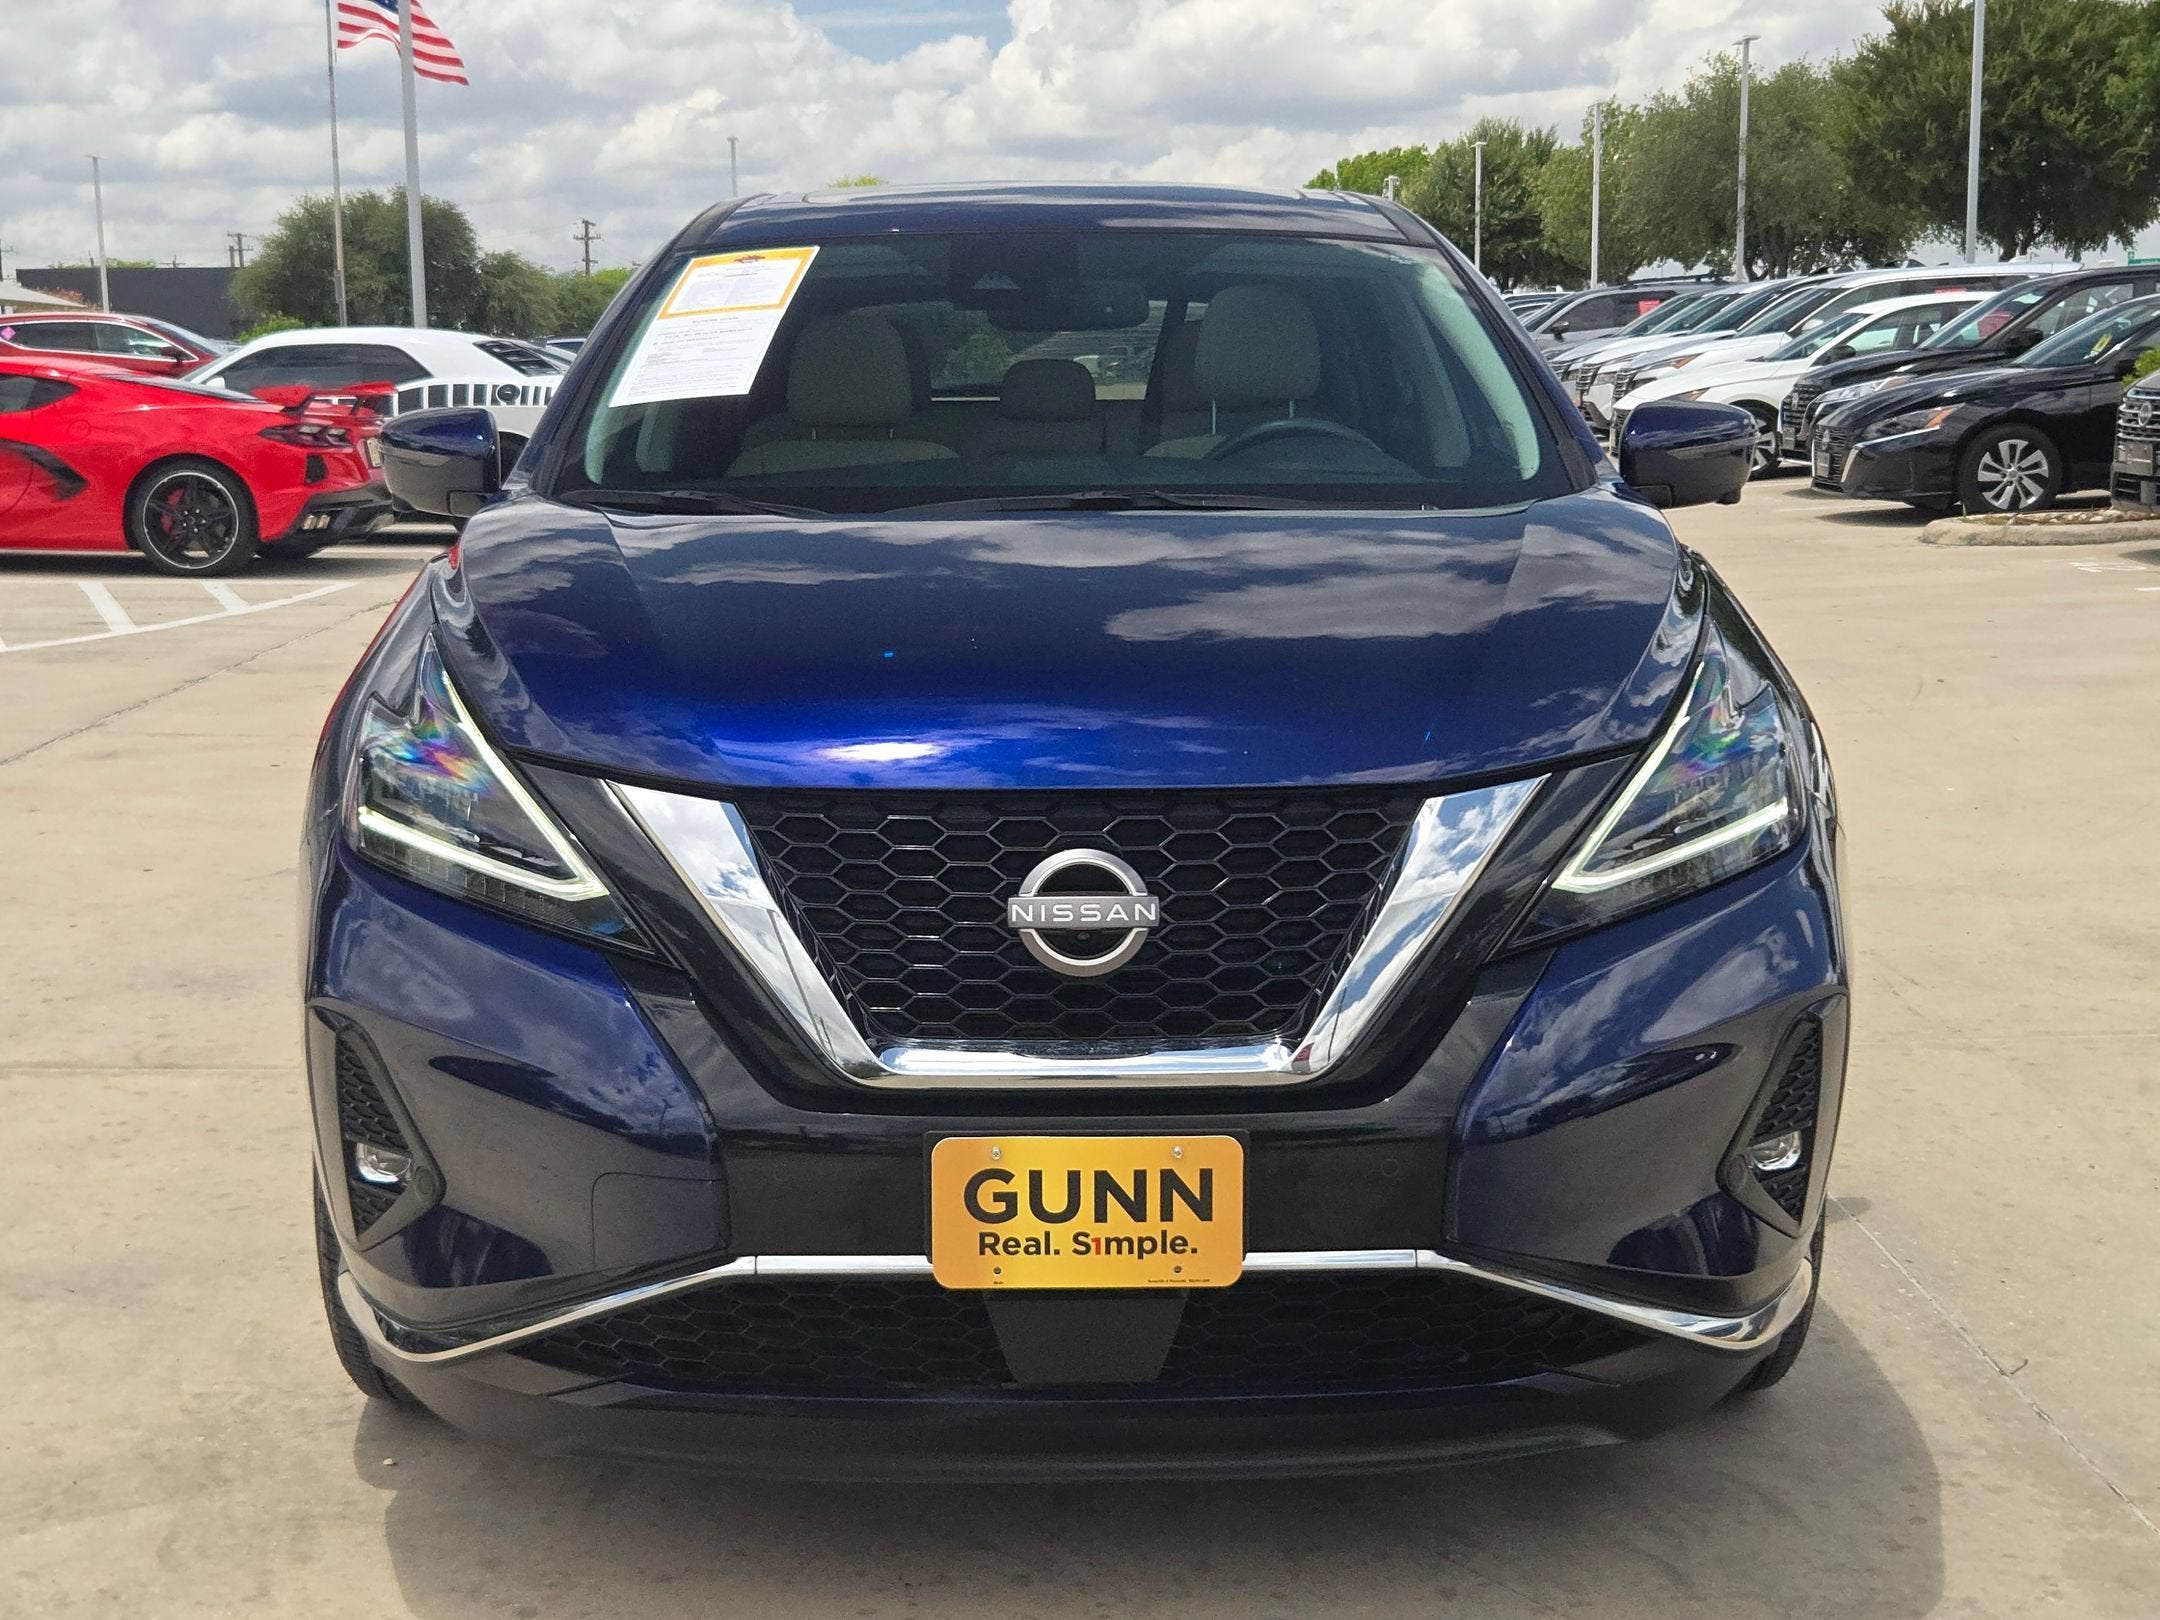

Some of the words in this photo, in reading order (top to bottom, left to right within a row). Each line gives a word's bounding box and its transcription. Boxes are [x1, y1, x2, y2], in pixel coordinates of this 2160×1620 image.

[1011, 903, 1156, 922] NISSAN
[963, 1168, 1213, 1224] GUNN
[978, 1230, 1060, 1256] Real.
